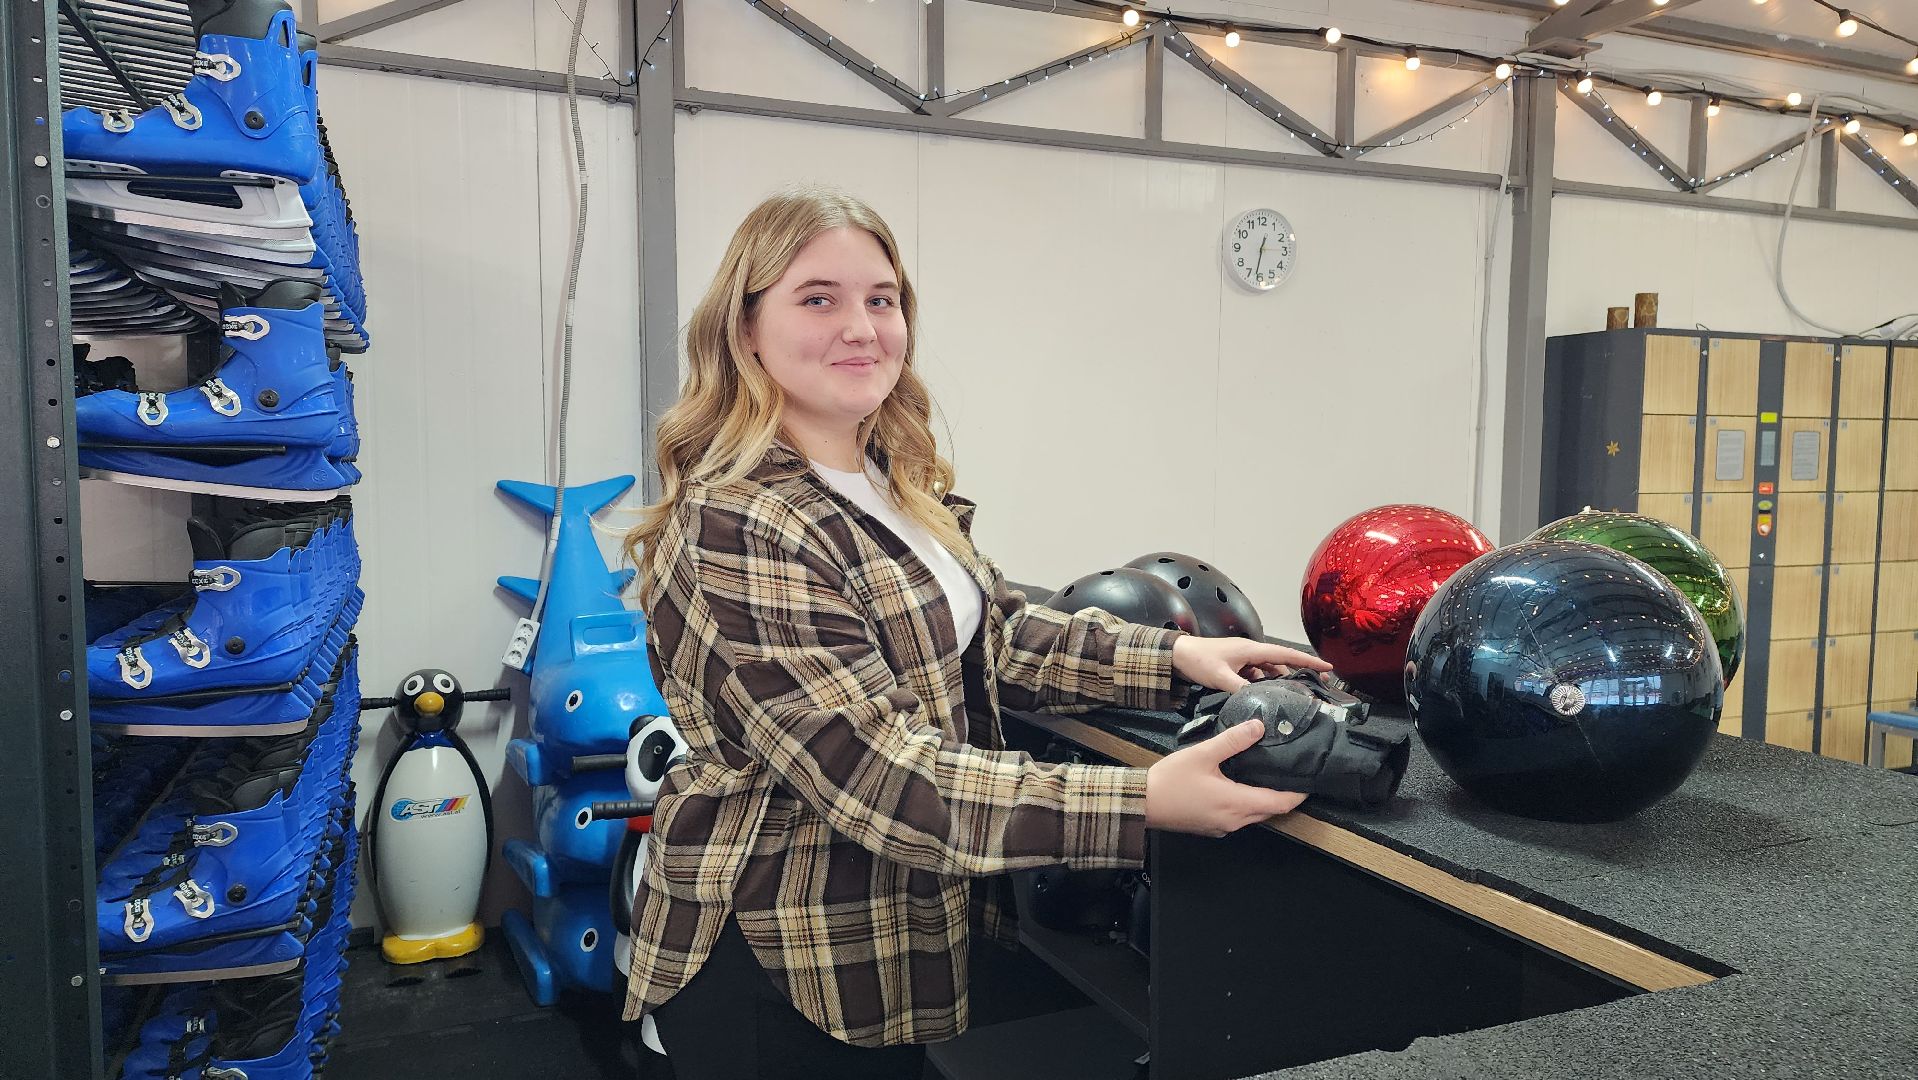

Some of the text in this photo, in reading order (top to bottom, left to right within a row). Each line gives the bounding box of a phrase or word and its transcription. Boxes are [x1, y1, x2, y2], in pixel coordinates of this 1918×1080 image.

[1247, 219, 1254, 229] 11
[1257, 216, 1267, 226] 12
[1272, 222, 1276, 231] 1
[1238, 229, 1248, 239] 10
[1277, 232, 1285, 242] 2
[1233, 242, 1241, 252] 9
[1281, 246, 1288, 256] 3
[1237, 257, 1245, 267] 8
[1276, 260, 1284, 270] 4
[1245, 267, 1253, 277] 7
[1268, 270, 1276, 279] 5
[1256, 273, 1263, 282] 6
[400, 801, 442, 816] AST
